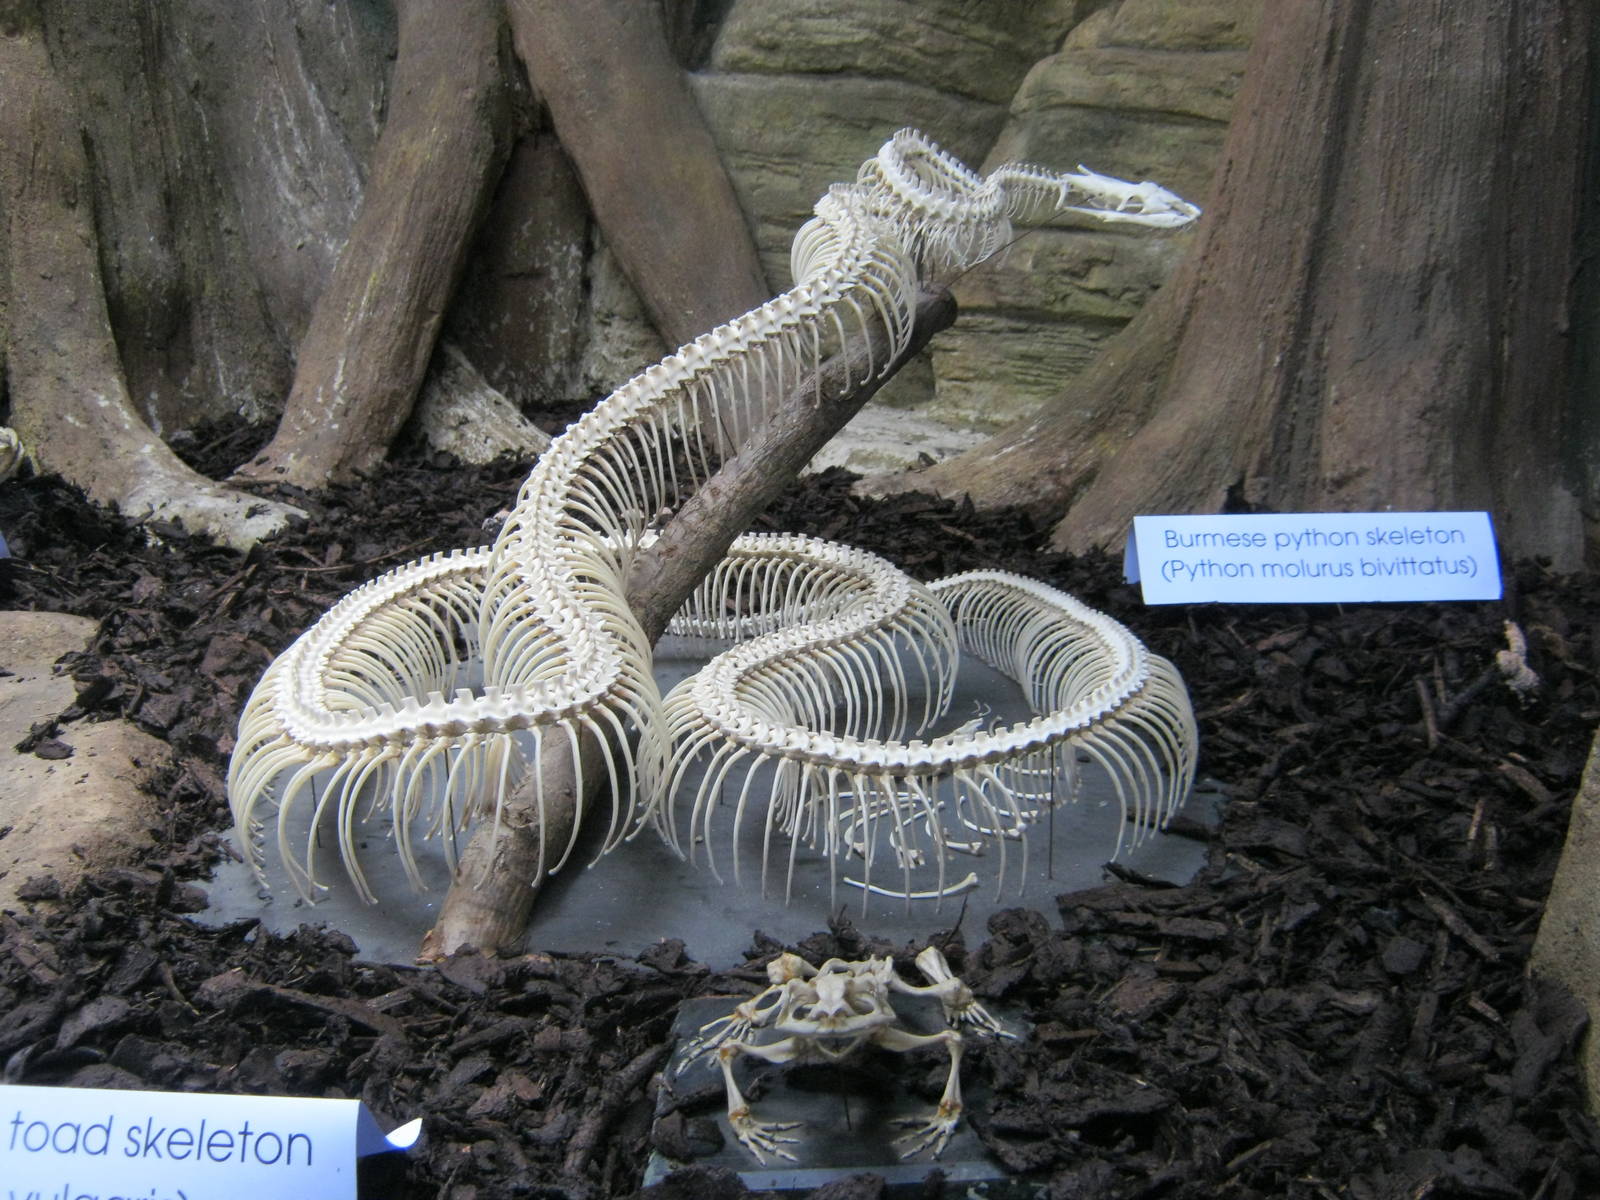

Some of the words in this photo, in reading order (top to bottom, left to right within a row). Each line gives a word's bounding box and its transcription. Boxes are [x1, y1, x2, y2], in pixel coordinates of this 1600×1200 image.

[1165, 529, 1267, 549] Burmese
[1275, 528, 1359, 551] python
[1366, 526, 1465, 546] skeleton
[1161, 559, 1253, 583] (Python
[1263, 558, 1353, 578] molurus
[1360, 555, 1478, 578] bivittatus)
[9, 1110, 114, 1156] toad
[124, 1116, 314, 1167] skeleton
